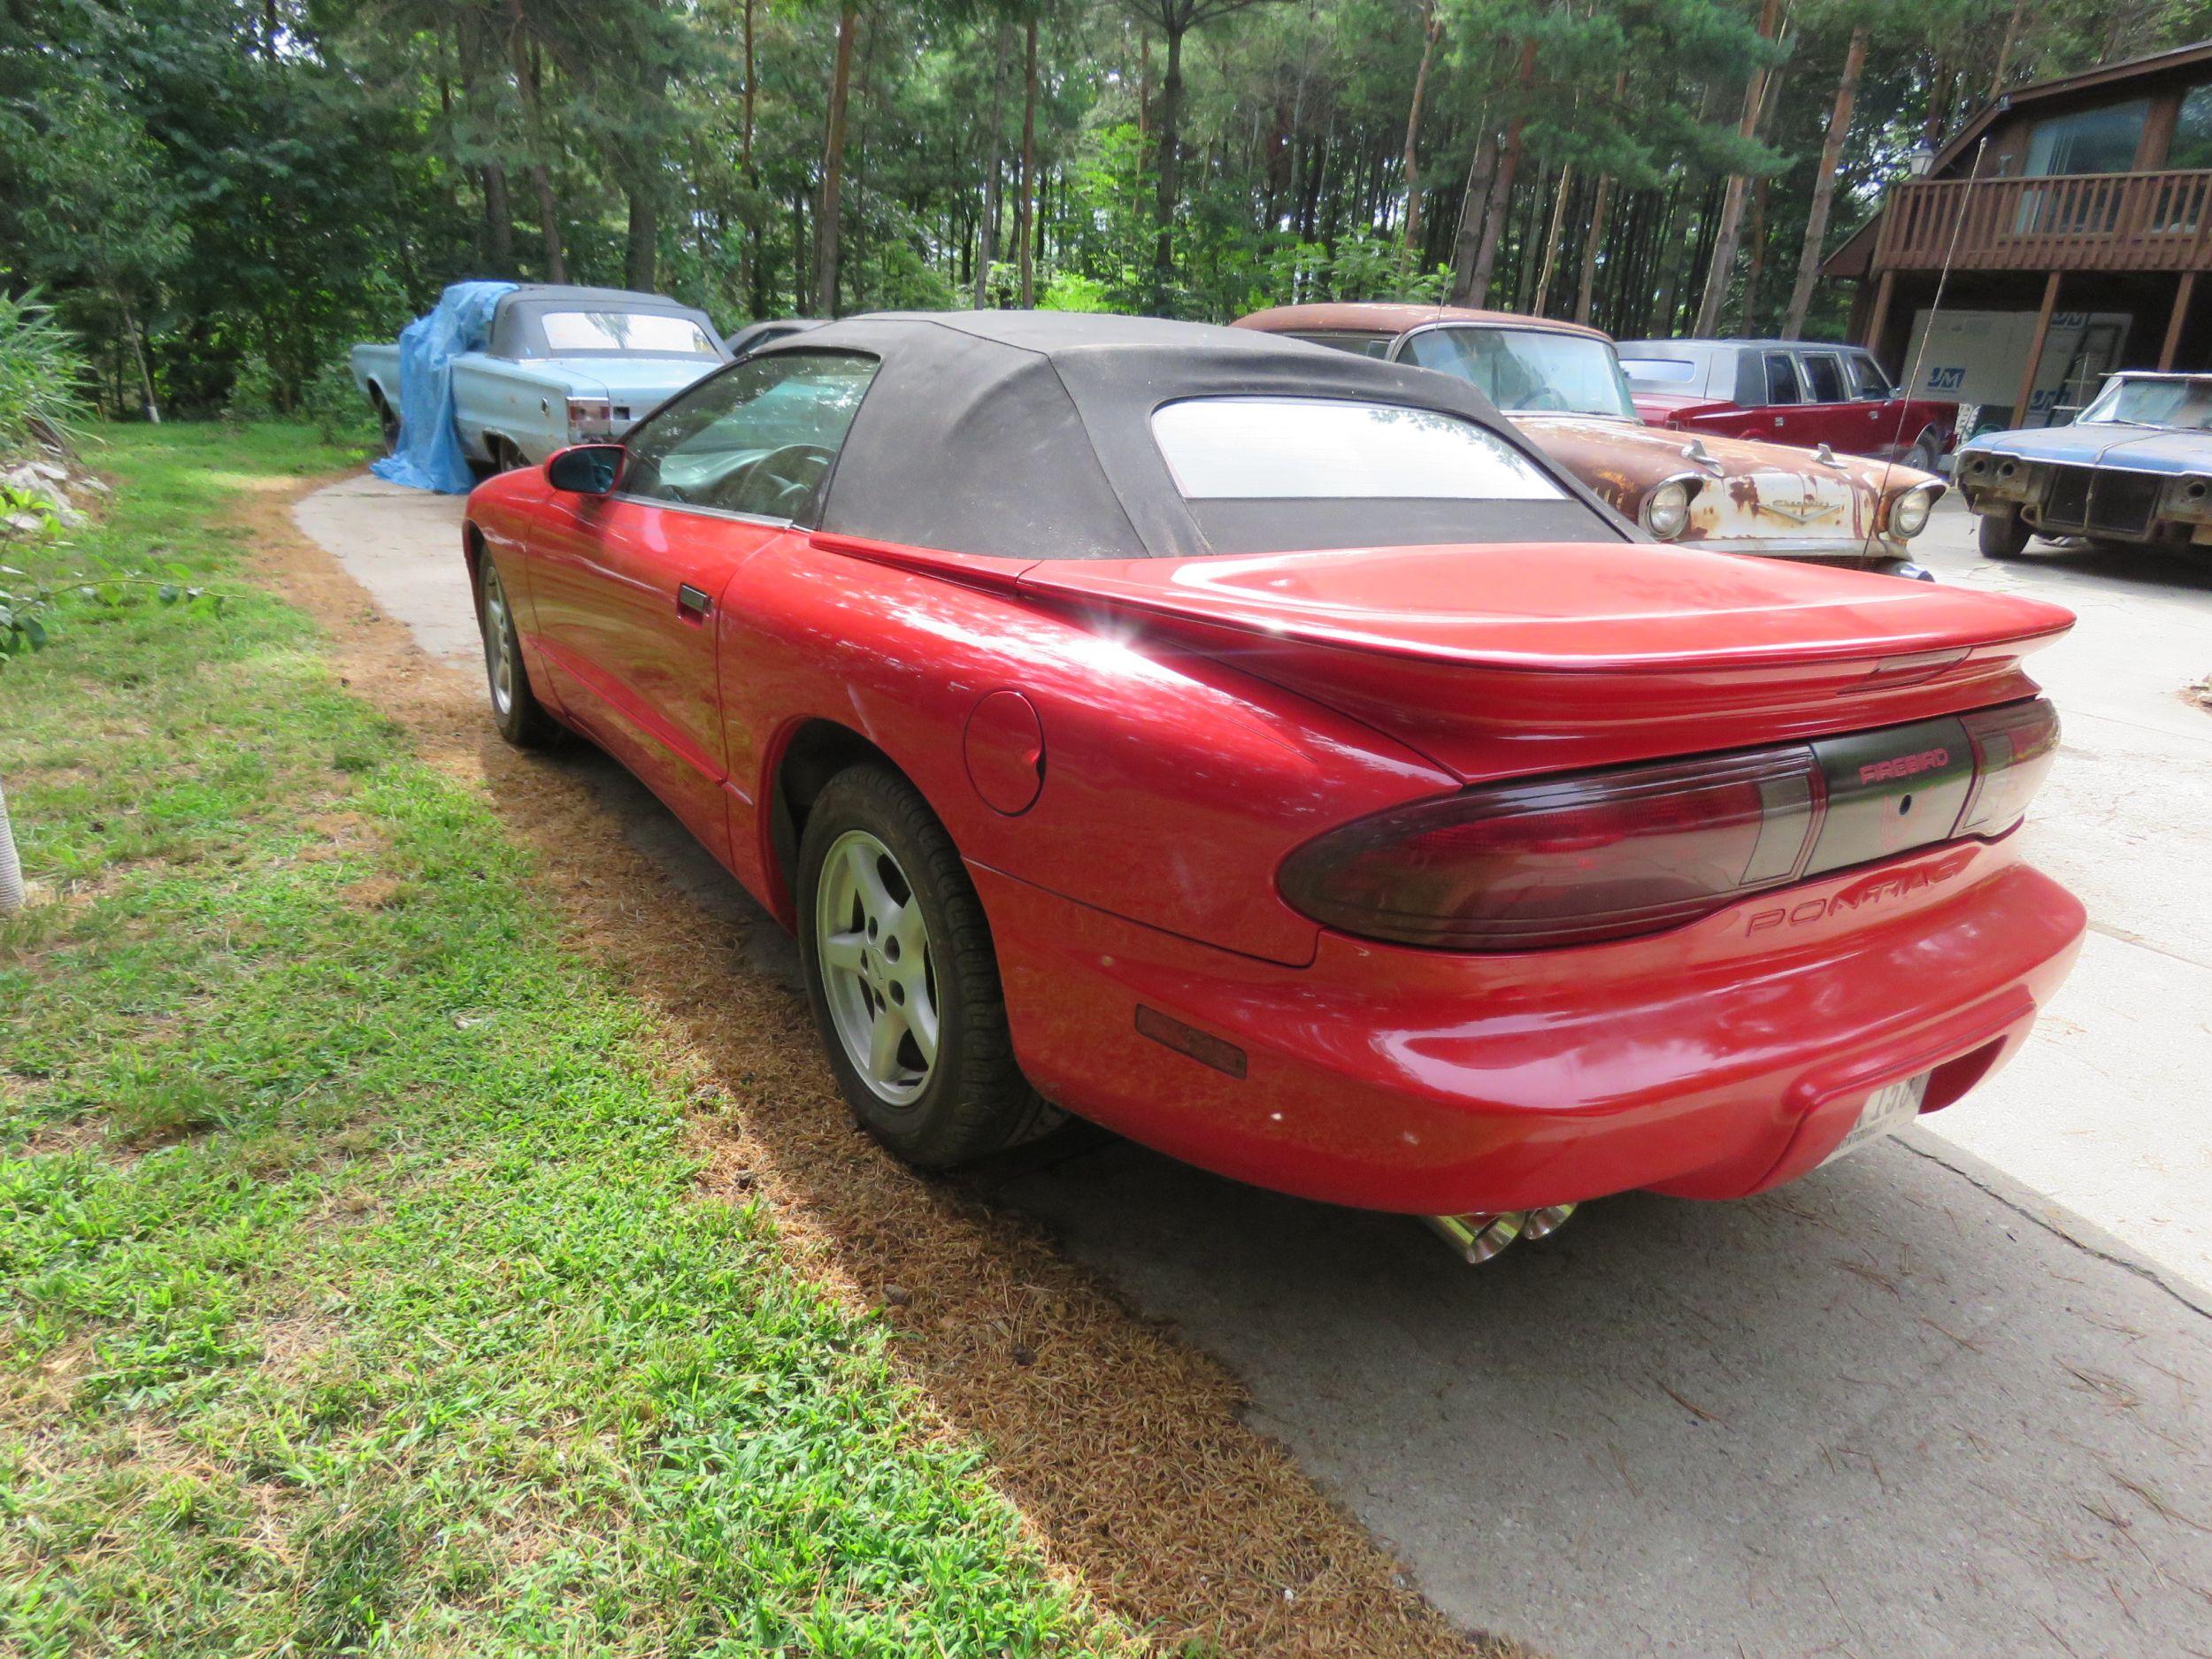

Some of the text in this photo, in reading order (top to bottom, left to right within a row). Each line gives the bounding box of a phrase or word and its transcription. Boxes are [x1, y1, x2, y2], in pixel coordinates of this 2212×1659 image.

[1928, 368, 1965, 388] JM
[1859, 749, 1948, 786] FIREBIRD
[1746, 861, 1958, 937] PONTIAC
